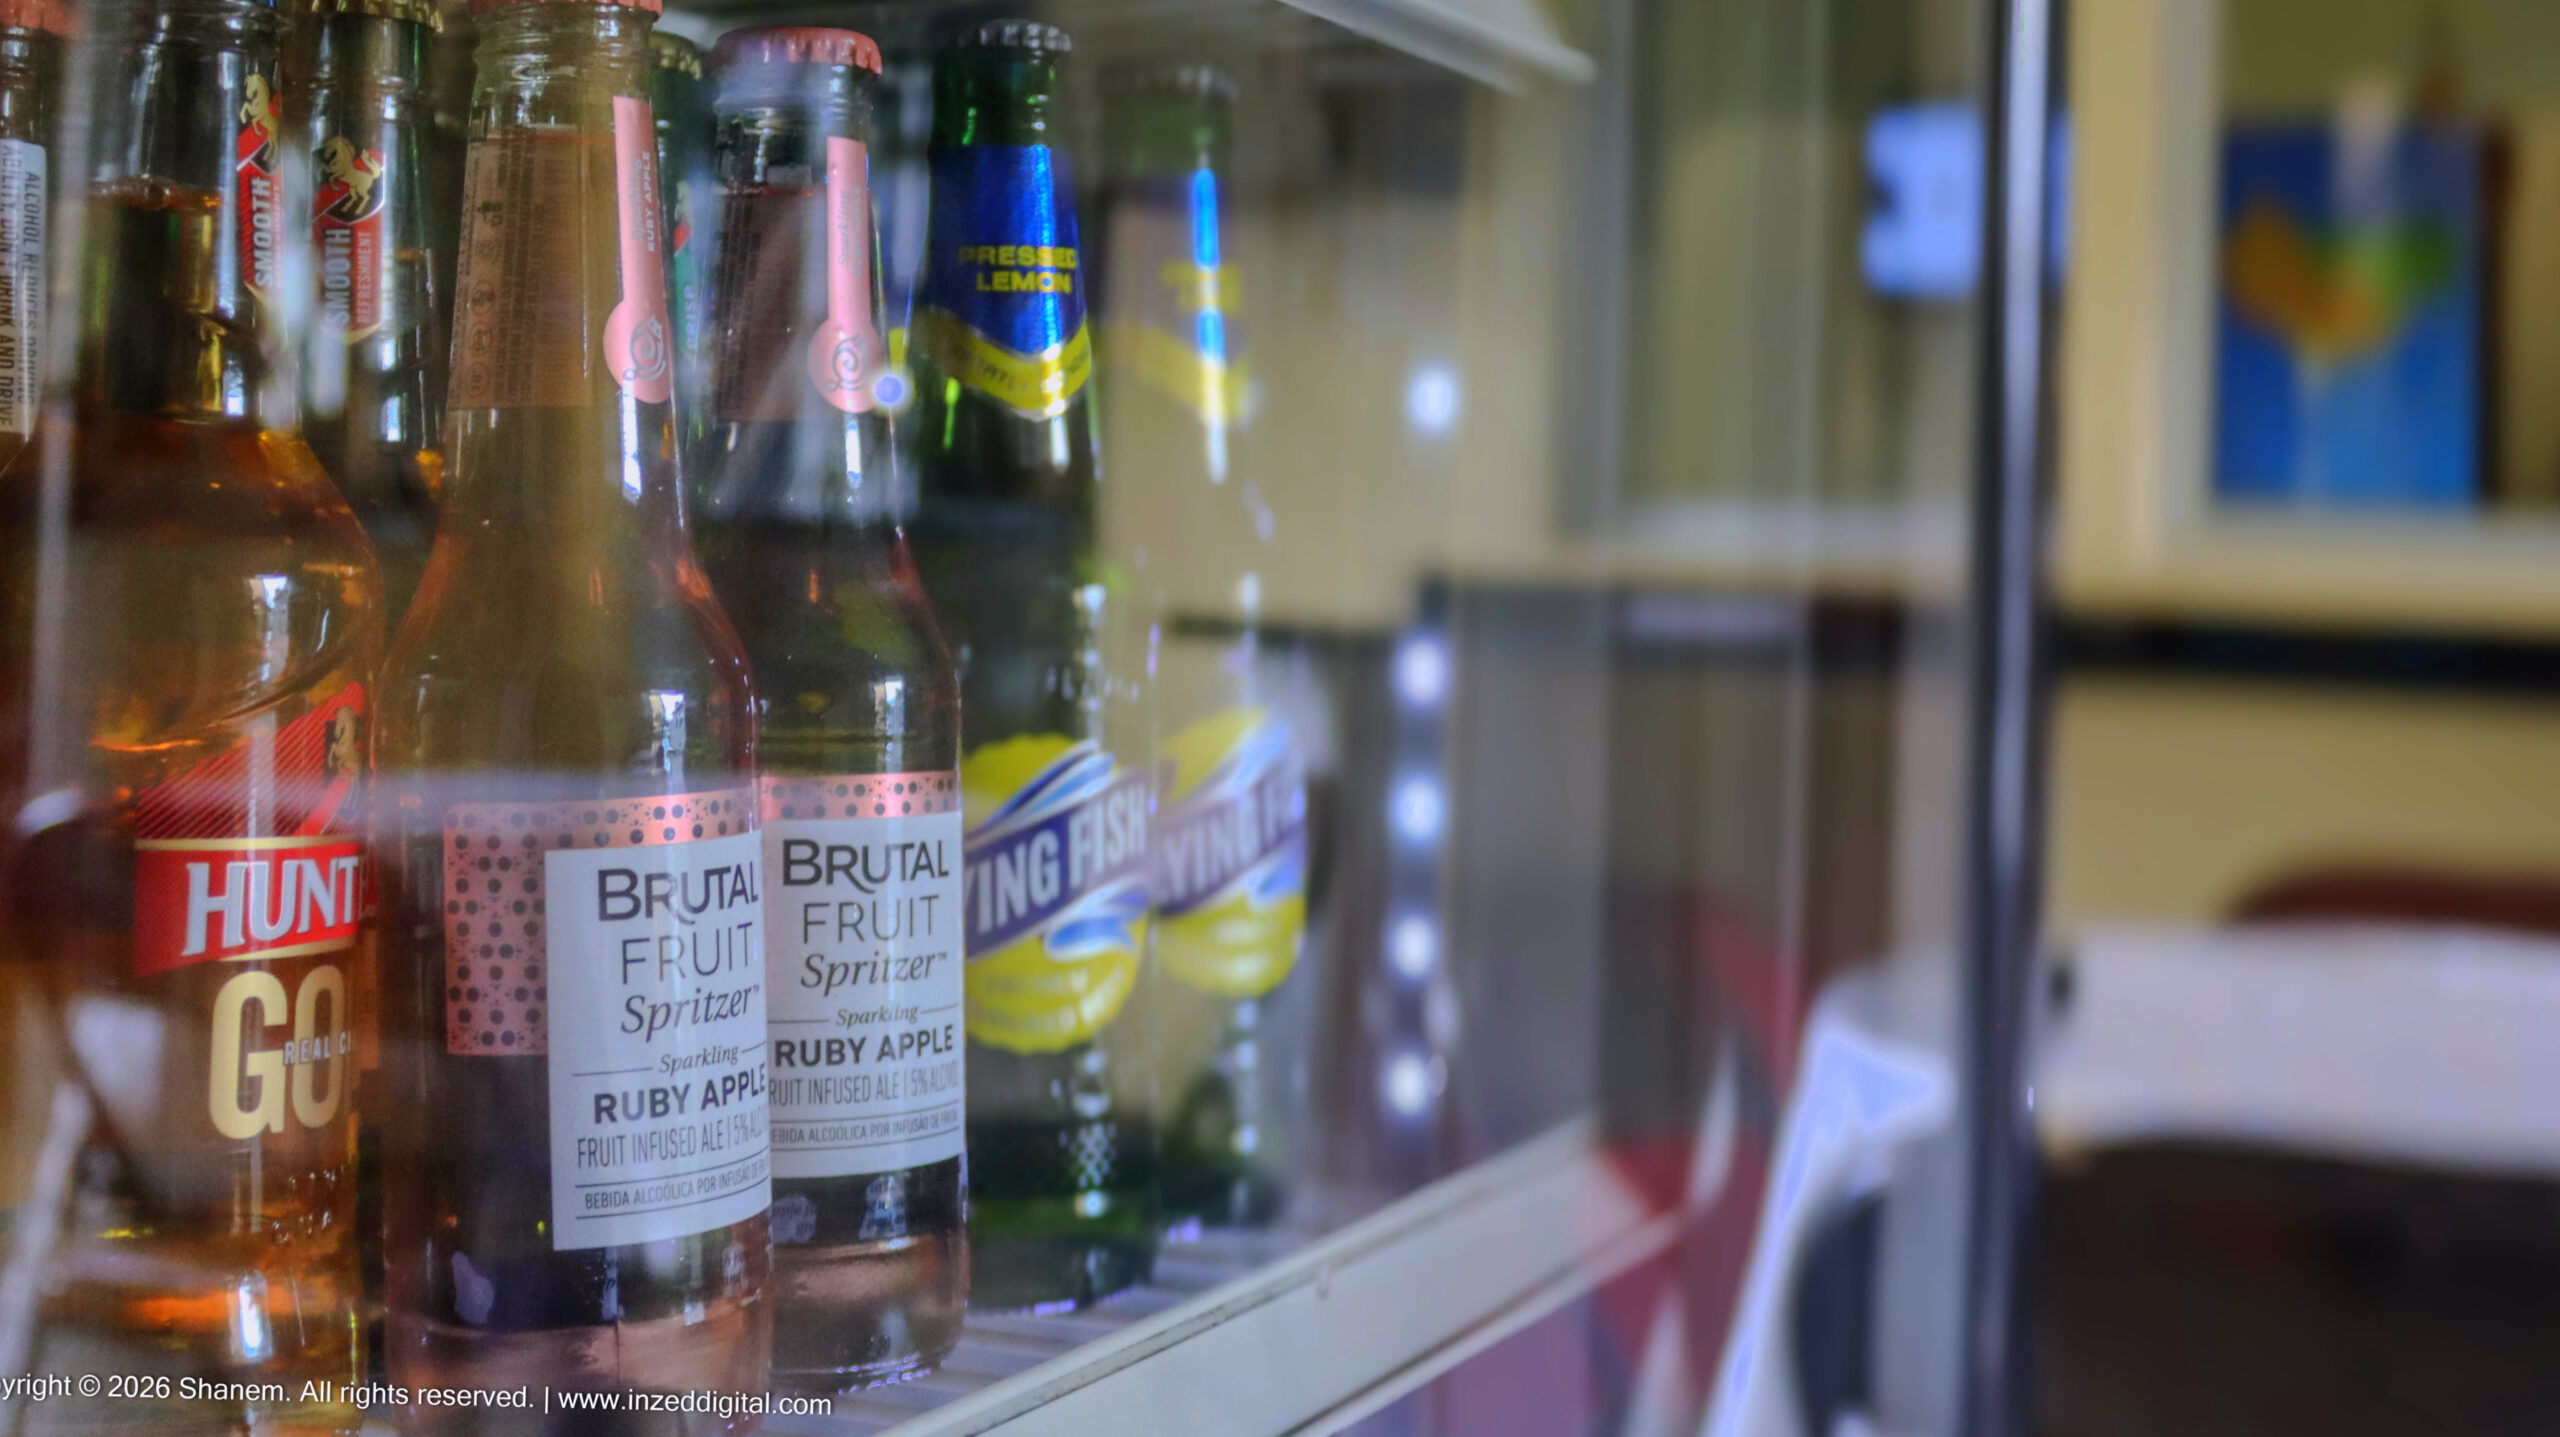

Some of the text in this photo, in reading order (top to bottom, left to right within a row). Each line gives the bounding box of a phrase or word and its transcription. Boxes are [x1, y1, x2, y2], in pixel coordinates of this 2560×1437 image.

[23, 172, 41, 246] ALCOHOL
[642, 151, 656, 252] RUBY APPLE
[251, 177, 273, 287] SMOOTH
[0, 275, 16, 328] DRINK
[325, 229, 352, 325] SMOOTH
[976, 271, 1072, 294] LEMON
[0, 335, 15, 370] AND
[0, 377, 14, 426] DRIVE
[1067, 783, 1147, 889] FISH
[783, 839, 949, 894] BRUTAL
[182, 855, 362, 956] HUNT
[597, 861, 759, 925] BRUTAL
[802, 895, 940, 945] FRUIT
[621, 922, 753, 985] FRUIT
[835, 1004, 919, 1030] Sparkling
[283, 1035, 331, 1065] REAL
[658, 1045, 739, 1076] Sparkling
[774, 1024, 954, 1068] RUBY APPLE
[594, 1063, 766, 1124] RUBY APPLE
[768, 1077, 805, 1107] RUIT
[808, 1075, 871, 1105] INFUSED
[875, 1071, 899, 1101] ALE
[911, 1068, 929, 1097] 5%
[577, 1135, 626, 1168] FRUIT
[632, 1126, 697, 1164] INFUSED
[701, 1120, 724, 1153] ALE
[770, 1128, 805, 1144] EBIDA
[870, 1122, 890, 1137] POR
[585, 1191, 630, 1210] BEBIDA
[697, 1176, 717, 1195] POR
